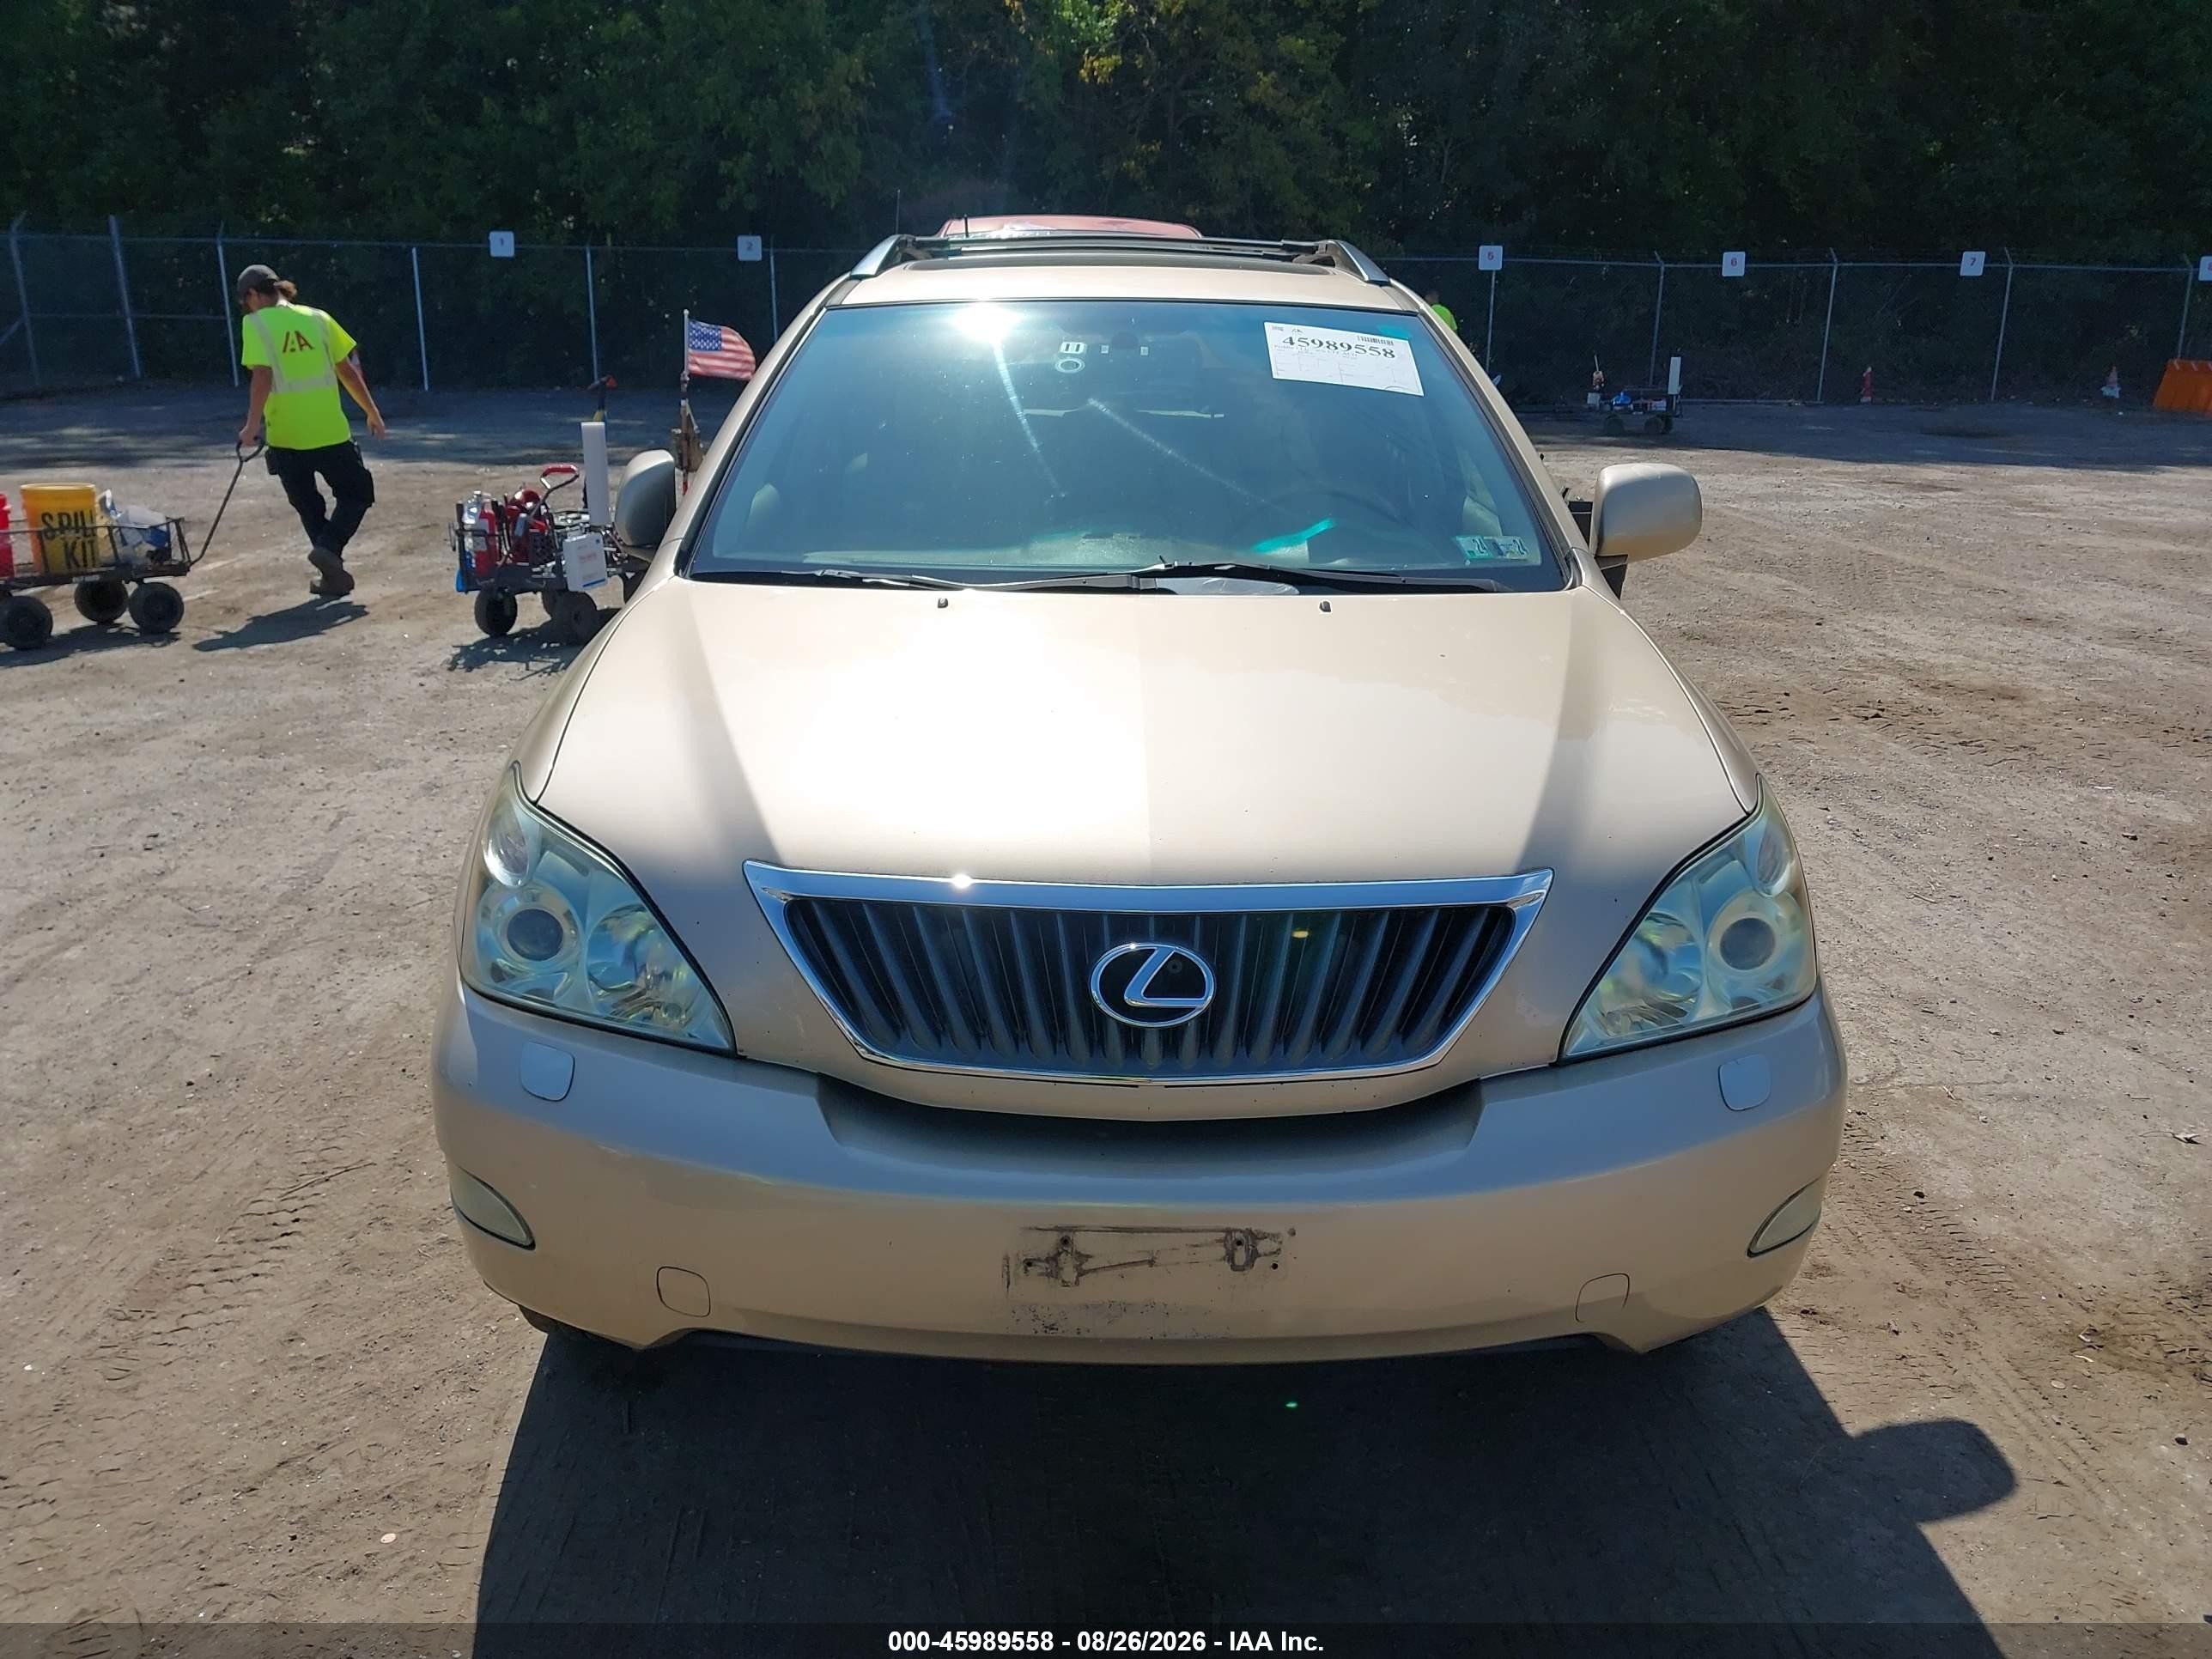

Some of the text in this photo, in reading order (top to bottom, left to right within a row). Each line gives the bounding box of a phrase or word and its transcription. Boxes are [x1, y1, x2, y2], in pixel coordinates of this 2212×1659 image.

[1730, 258, 1738, 267] 6
[1970, 257, 1977, 266] 7
[1282, 336, 1395, 359] 45989558
[62, 536, 99, 568] KIT
